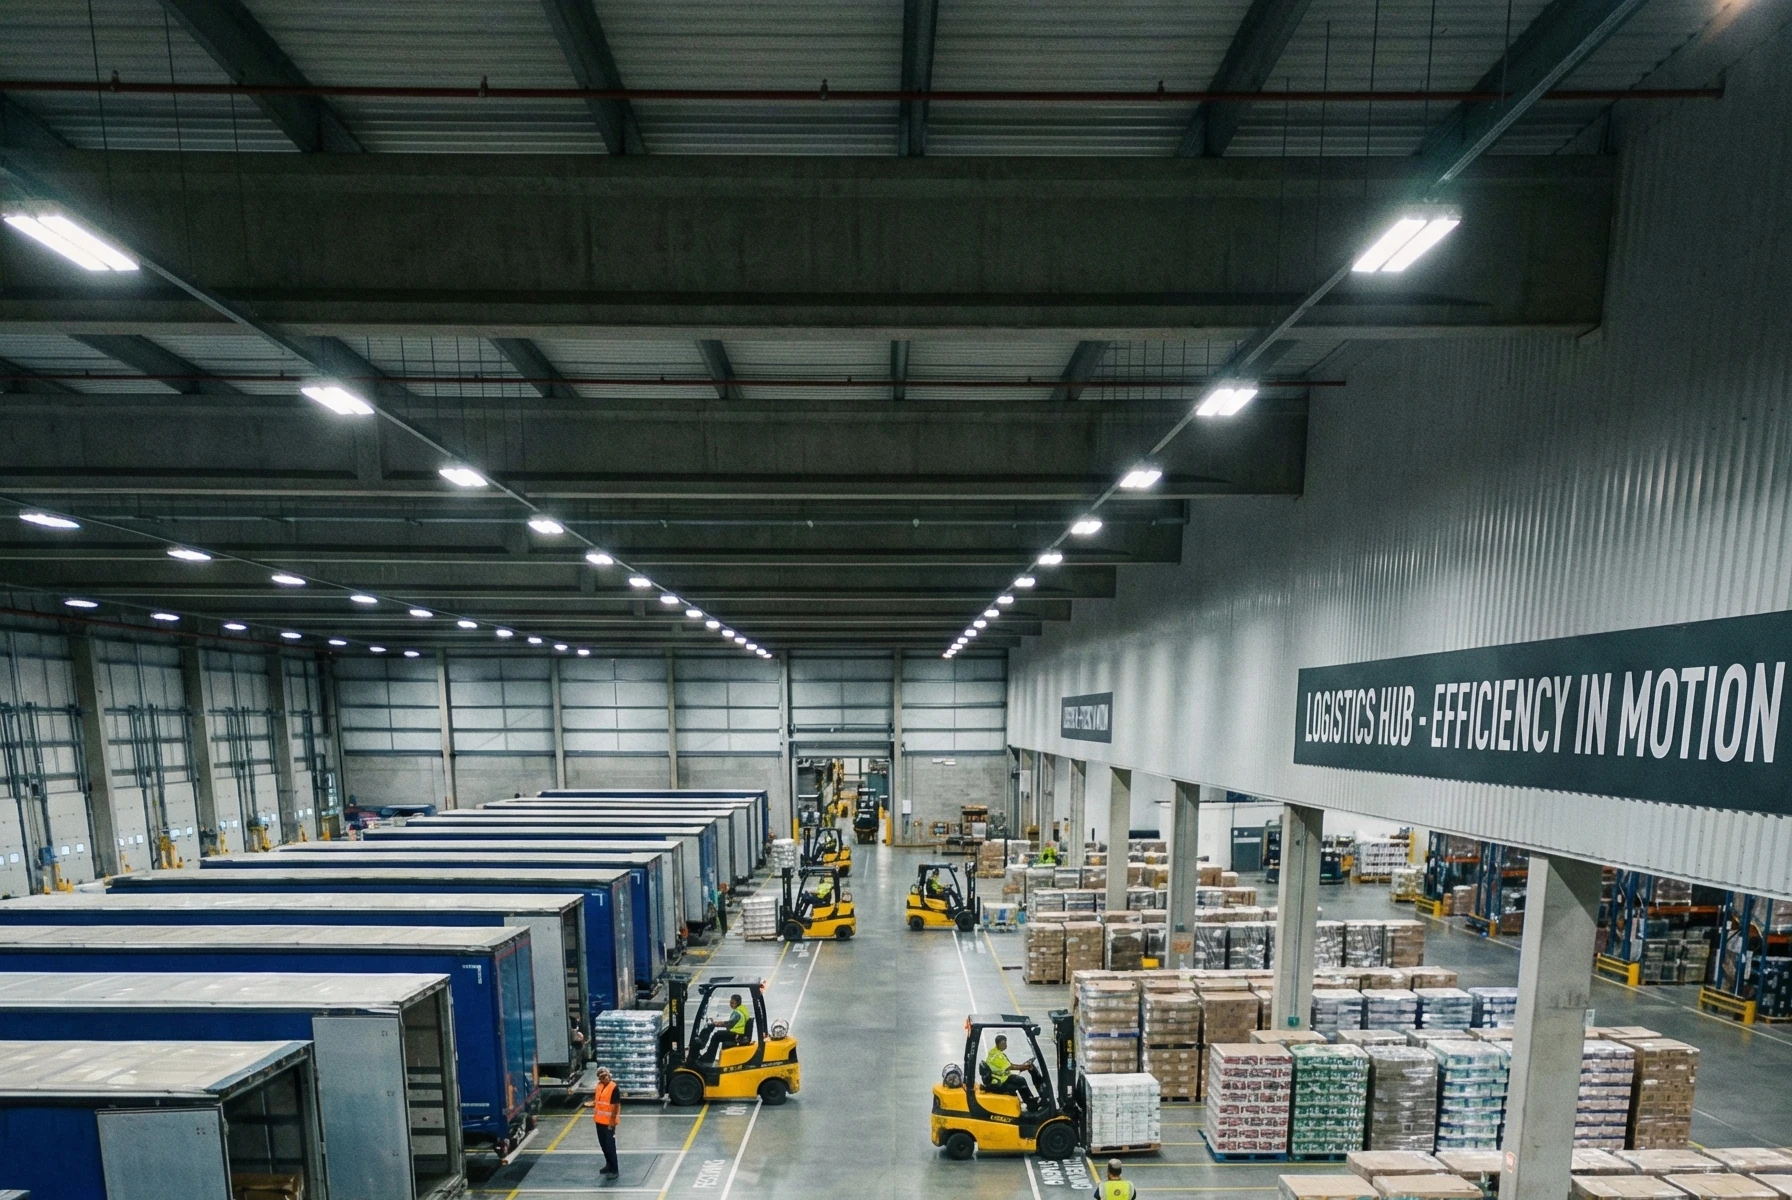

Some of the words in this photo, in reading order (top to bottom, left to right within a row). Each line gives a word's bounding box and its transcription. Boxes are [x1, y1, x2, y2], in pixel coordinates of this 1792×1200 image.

[1304, 687, 1376, 745] LOGISTICS
[1377, 685, 1415, 747] HUB
[1430, 676, 1572, 753] EFFICIENCY
[1574, 672, 1612, 756] IN
[1616, 661, 1786, 764] MOTION
